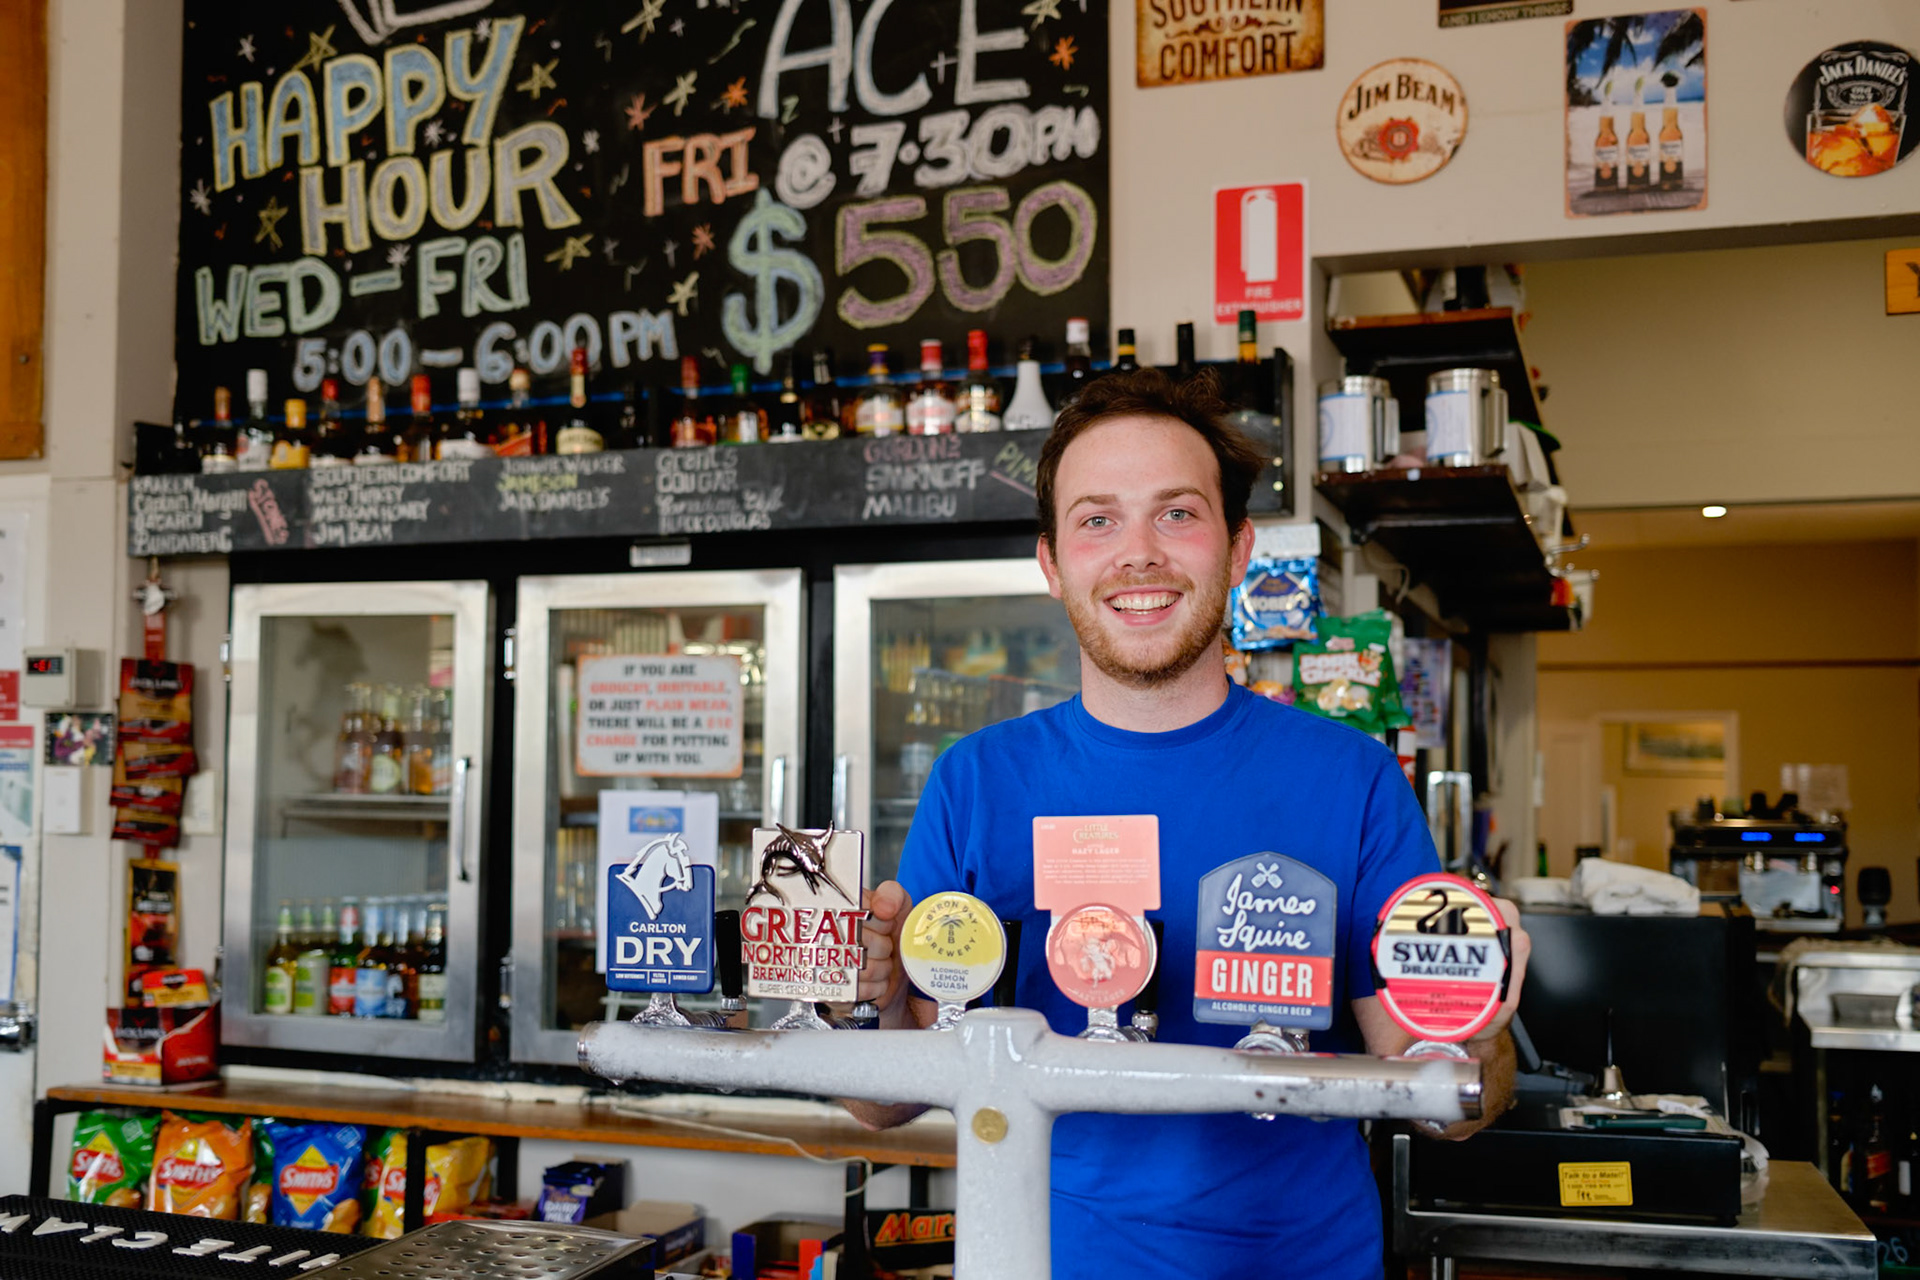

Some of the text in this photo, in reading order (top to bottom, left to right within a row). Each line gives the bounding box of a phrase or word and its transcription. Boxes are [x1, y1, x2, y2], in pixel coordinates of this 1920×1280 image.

[757, 0, 1031, 118] ACE
[1160, 31, 1298, 81] COMFORT
[1819, 55, 1908, 86] JACK DANIEL'S
[210, 15, 526, 193] HAPPY
[1348, 73, 1456, 120] JIM BEAM
[643, 127, 760, 217] FRI
[776, 134, 835, 209] @
[299, 120, 582, 257] HOUR
[1245, 286, 1272, 298] FIRE
[1216, 298, 1302, 316] EXTINGUISHER
[400, 460, 474, 483] COMFORT
[862, 492, 957, 521] MALIBU
[624, 663, 696, 676] IF YOU ARE
[589, 699, 605, 711] OR
[610, 699, 641, 711] JUST
[646, 700, 684, 712] PLAIN
[588, 717, 630, 729] THERE
[636, 717, 665, 729] WILL
[672, 717, 687, 729] BE
[694, 717, 702, 729] A
[586, 734, 729, 747] CHARGE FOR PUTTING
[614, 752, 630, 765] UP
[636, 752, 670, 765] WITH
[1222, 873, 1317, 915] James
[926, 900, 959, 922] BYRON
[629, 921, 687, 934] CARLTON
[740, 907, 869, 947] GREAT
[1216, 909, 1312, 952] Squire
[616, 936, 702, 966] DRY
[742, 942, 866, 970] NORTHERN
[1392, 942, 1489, 966] SWAN
[752, 966, 814, 983] BREWING
[930, 967, 969, 975] ALCOHOLIC
[933, 973, 965, 982] LEMON
[1211, 958, 1313, 998] GINGER
[1401, 964, 1481, 977] DRAUGHT
[812, 986, 842, 996] LAGER
[930, 981, 968, 990] SQUASH
[1211, 1001, 1312, 1016] ALCOHOLIC GINGER BEER
[544, 1201, 581, 1213] DAIRY
